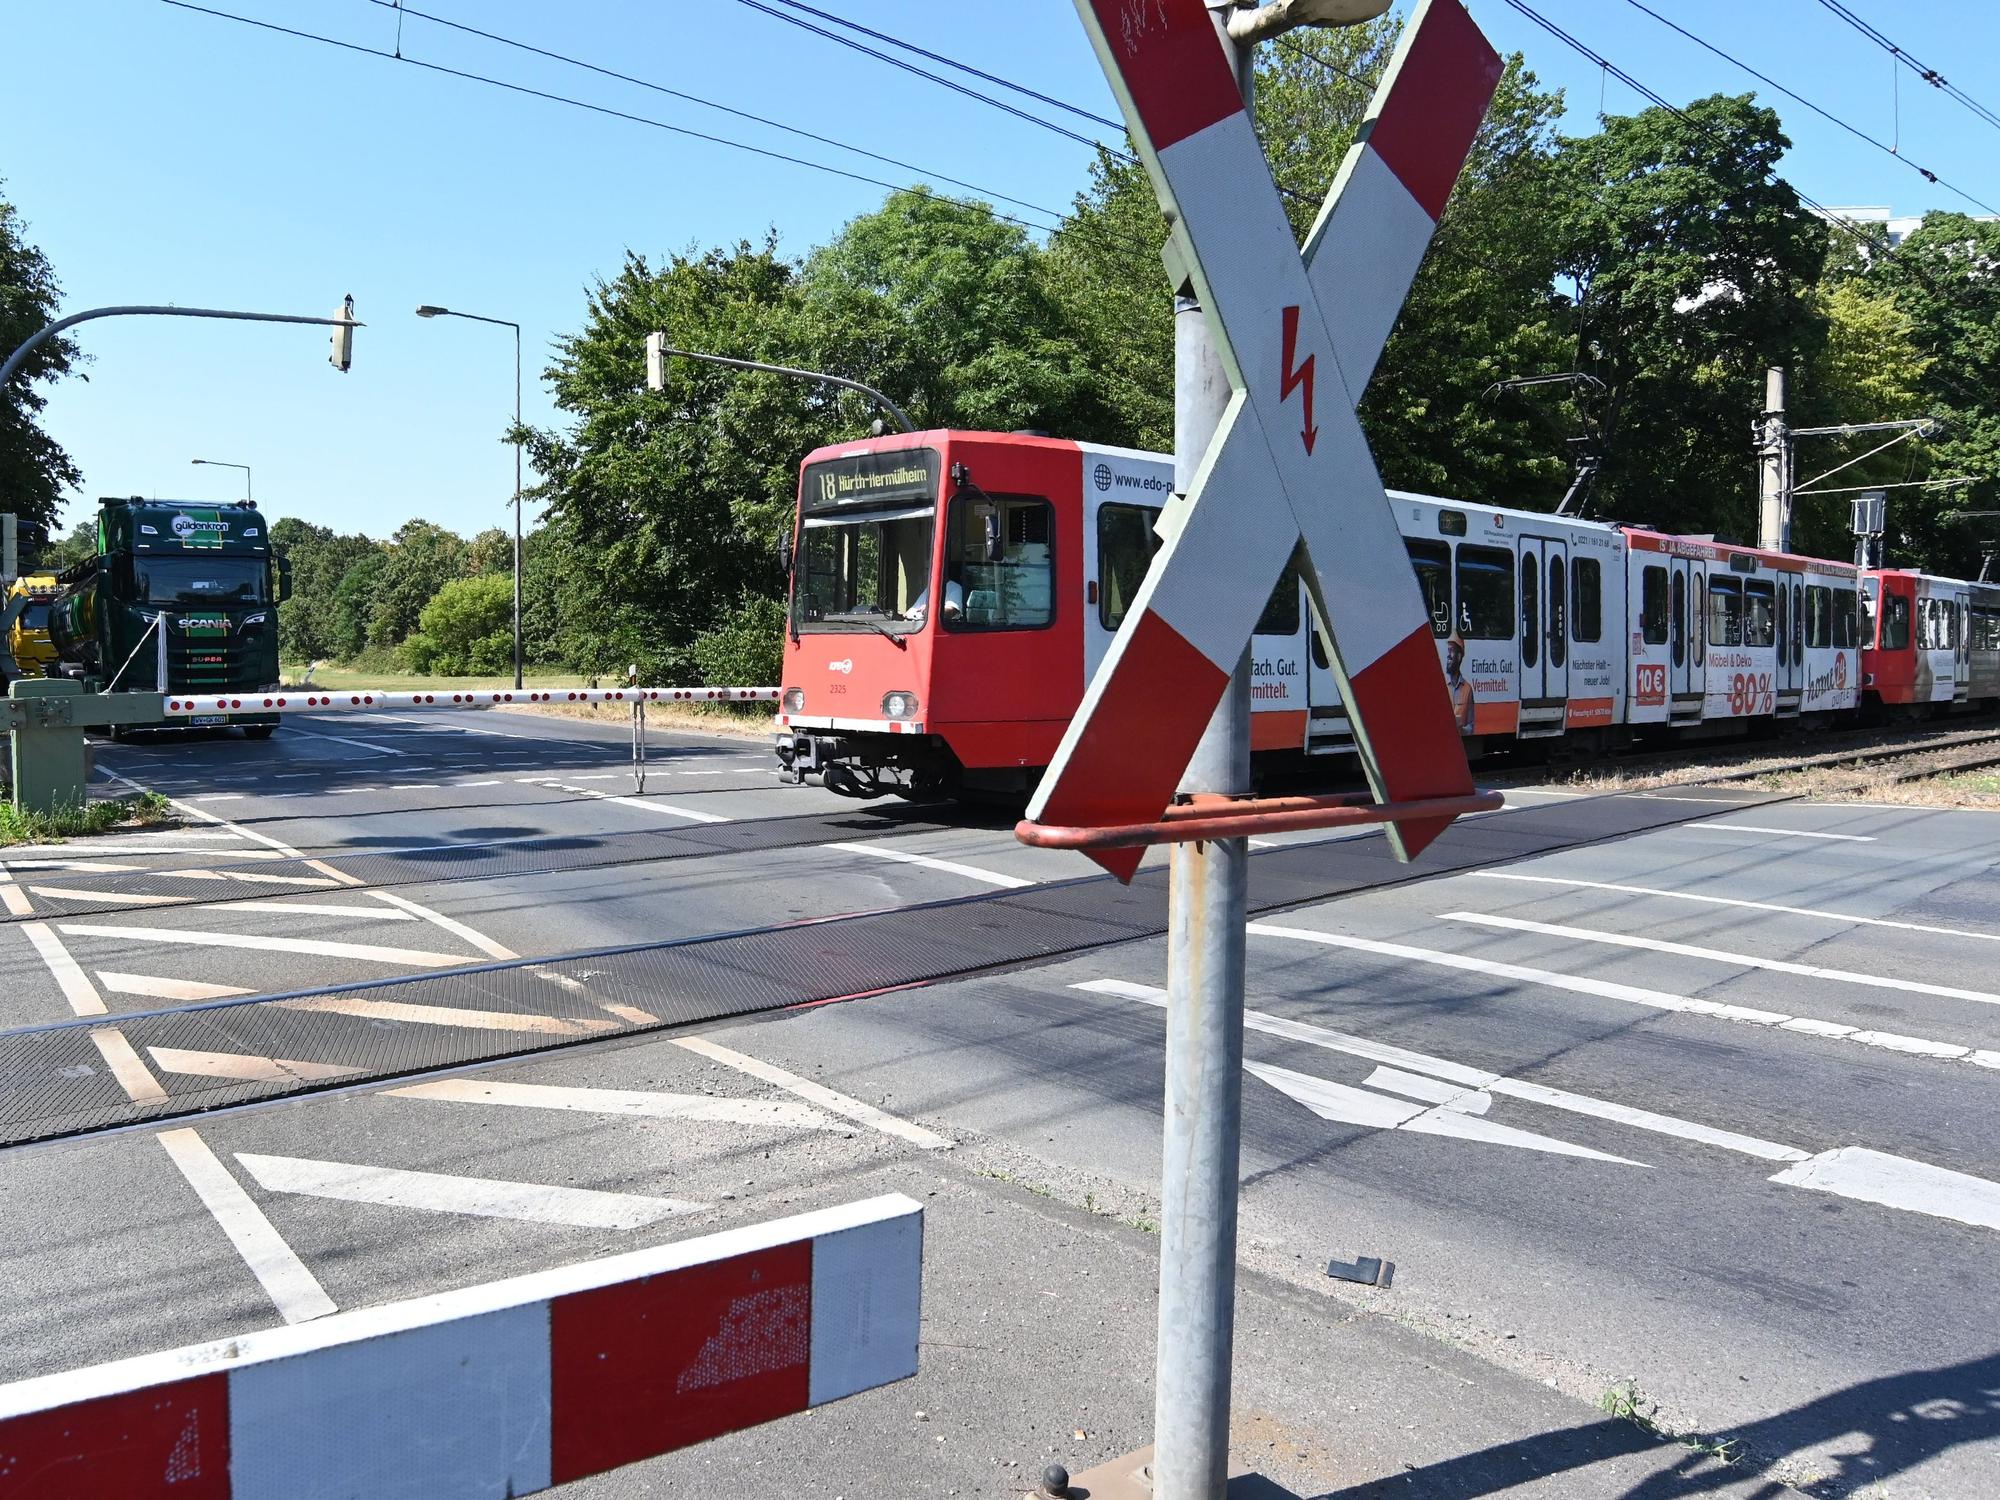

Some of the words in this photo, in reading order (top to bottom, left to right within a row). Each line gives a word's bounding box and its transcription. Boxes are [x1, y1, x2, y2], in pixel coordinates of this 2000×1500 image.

[819, 473, 836, 500] 18
[838, 465, 927, 491] Hürth-Hermülheim
[175, 520, 228, 533] güldenkron
[1668, 541, 1677, 554] JA
[1677, 543, 1717, 560] ABGEFAHREN
[178, 619, 232, 629] SCANIA
[1277, 658, 1298, 676] Gut.
[1471, 658, 1499, 673] Einfach.
[1499, 659, 1514, 673] Gut.
[1572, 659, 1595, 670] Nächster
[1595, 659, 1607, 670] Halt
[1708, 653, 1729, 668] Möbel
[1729, 653, 1735, 668] &
[1735, 653, 1752, 668] Deko
[1472, 678, 1509, 692] Vermittelt.
[1583, 677, 1598, 686] neuer
[1639, 669, 1652, 693] 10
[1653, 668, 1663, 693] €
[1250, 681, 1289, 699] mittelt.
